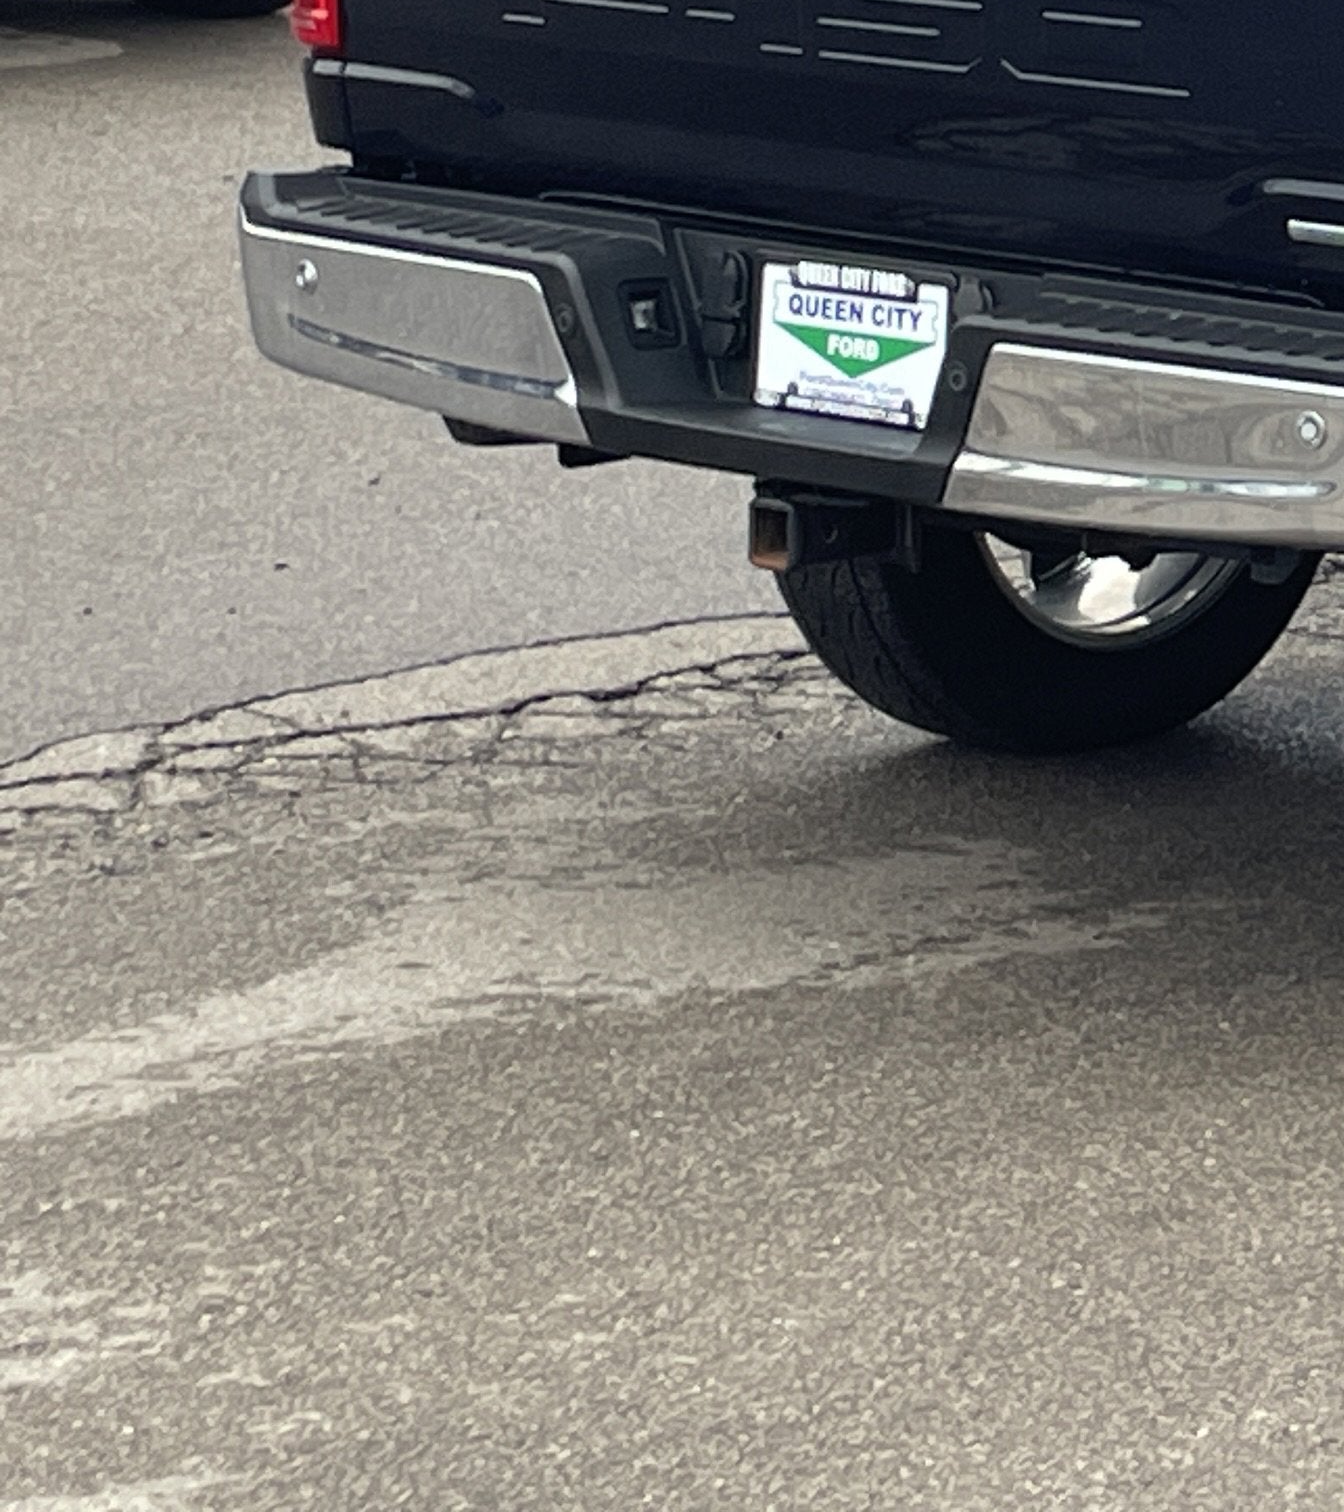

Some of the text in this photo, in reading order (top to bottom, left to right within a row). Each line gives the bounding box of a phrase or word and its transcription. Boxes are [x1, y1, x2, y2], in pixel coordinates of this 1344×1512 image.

[788, 293, 923, 333] QUEEN CITY
[826, 333, 880, 363] FORD
